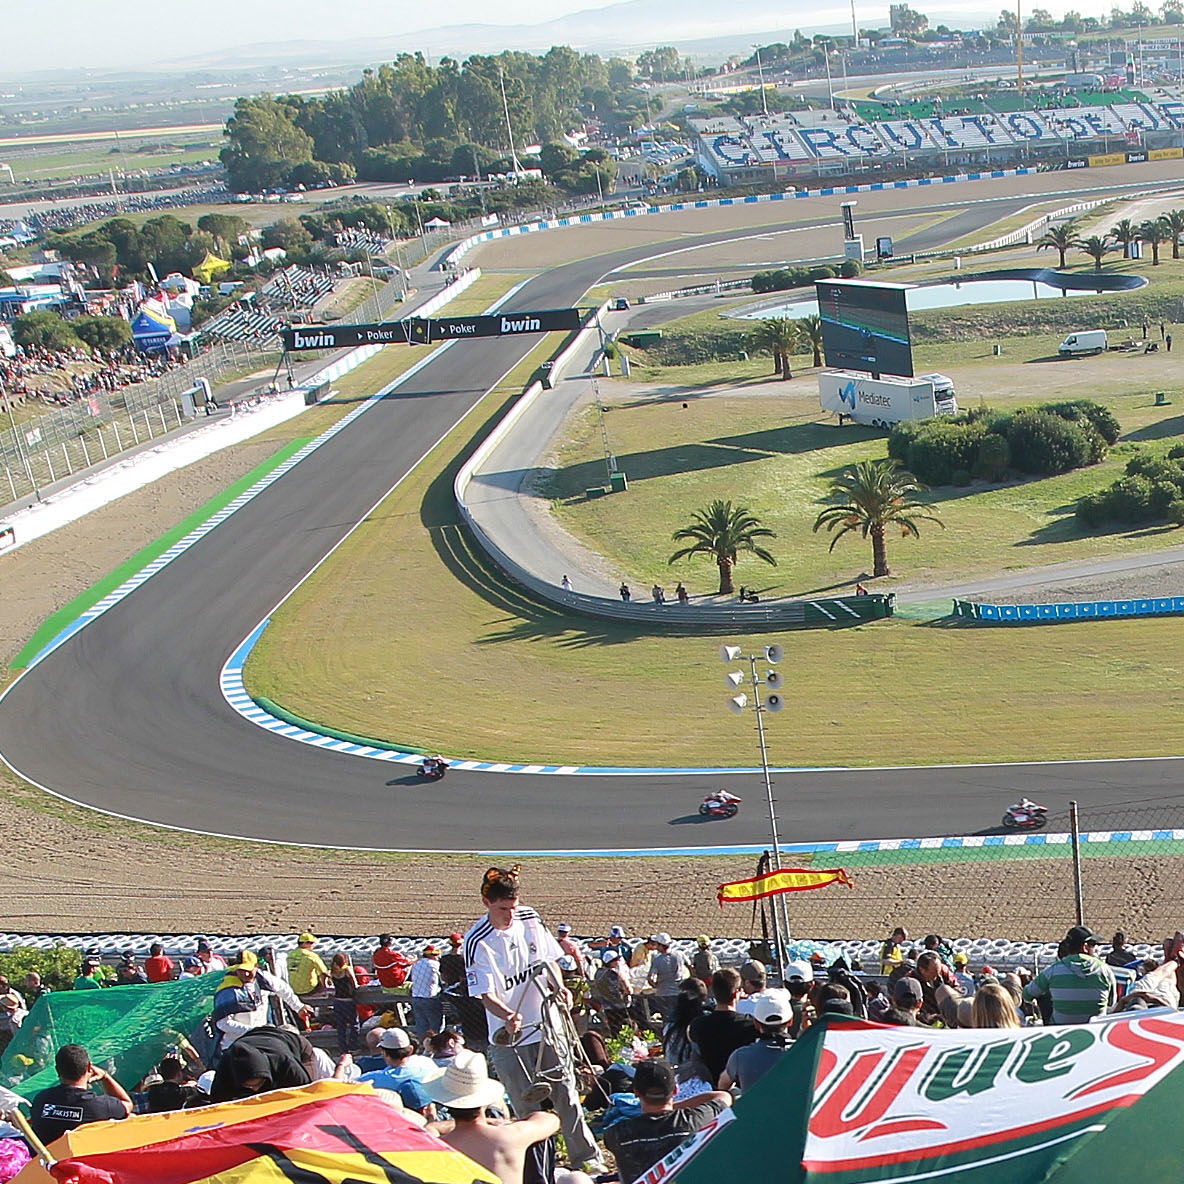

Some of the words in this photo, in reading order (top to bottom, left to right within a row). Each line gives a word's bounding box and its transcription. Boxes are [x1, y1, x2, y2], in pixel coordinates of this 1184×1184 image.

[712, 113, 1043, 163] CIRCUITO
[1067, 159, 1085, 168] bwin
[1128, 153, 1145, 162] bwin
[450, 323, 476, 334] Poker
[501, 315, 541, 332] bwin
[294, 331, 334, 348] bwin
[367, 330, 394, 340] Poker
[858, 391, 892, 408] Mediatec
